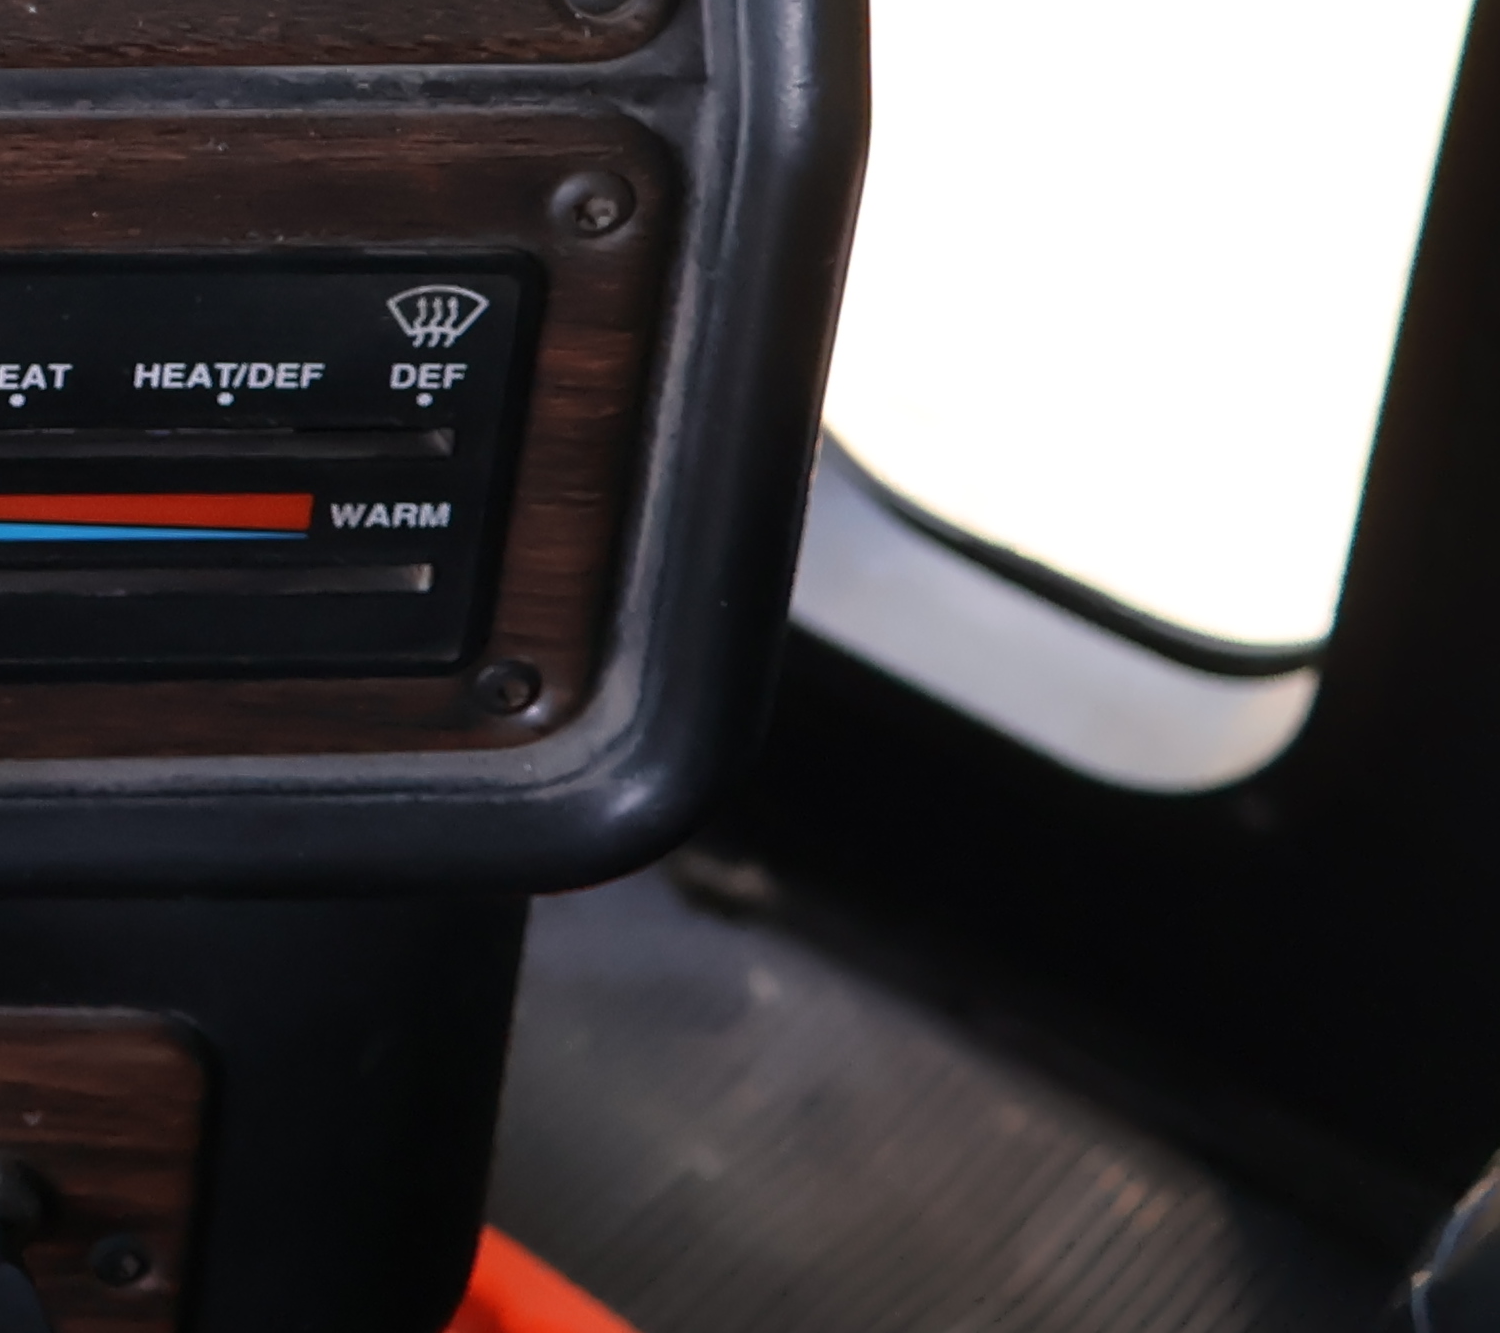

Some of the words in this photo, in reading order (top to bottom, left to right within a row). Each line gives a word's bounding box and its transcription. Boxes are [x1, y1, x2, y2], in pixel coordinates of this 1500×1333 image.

[133, 362, 325, 390] HEAT/DEF
[389, 363, 467, 390] DEF
[330, 502, 451, 529] WARM
